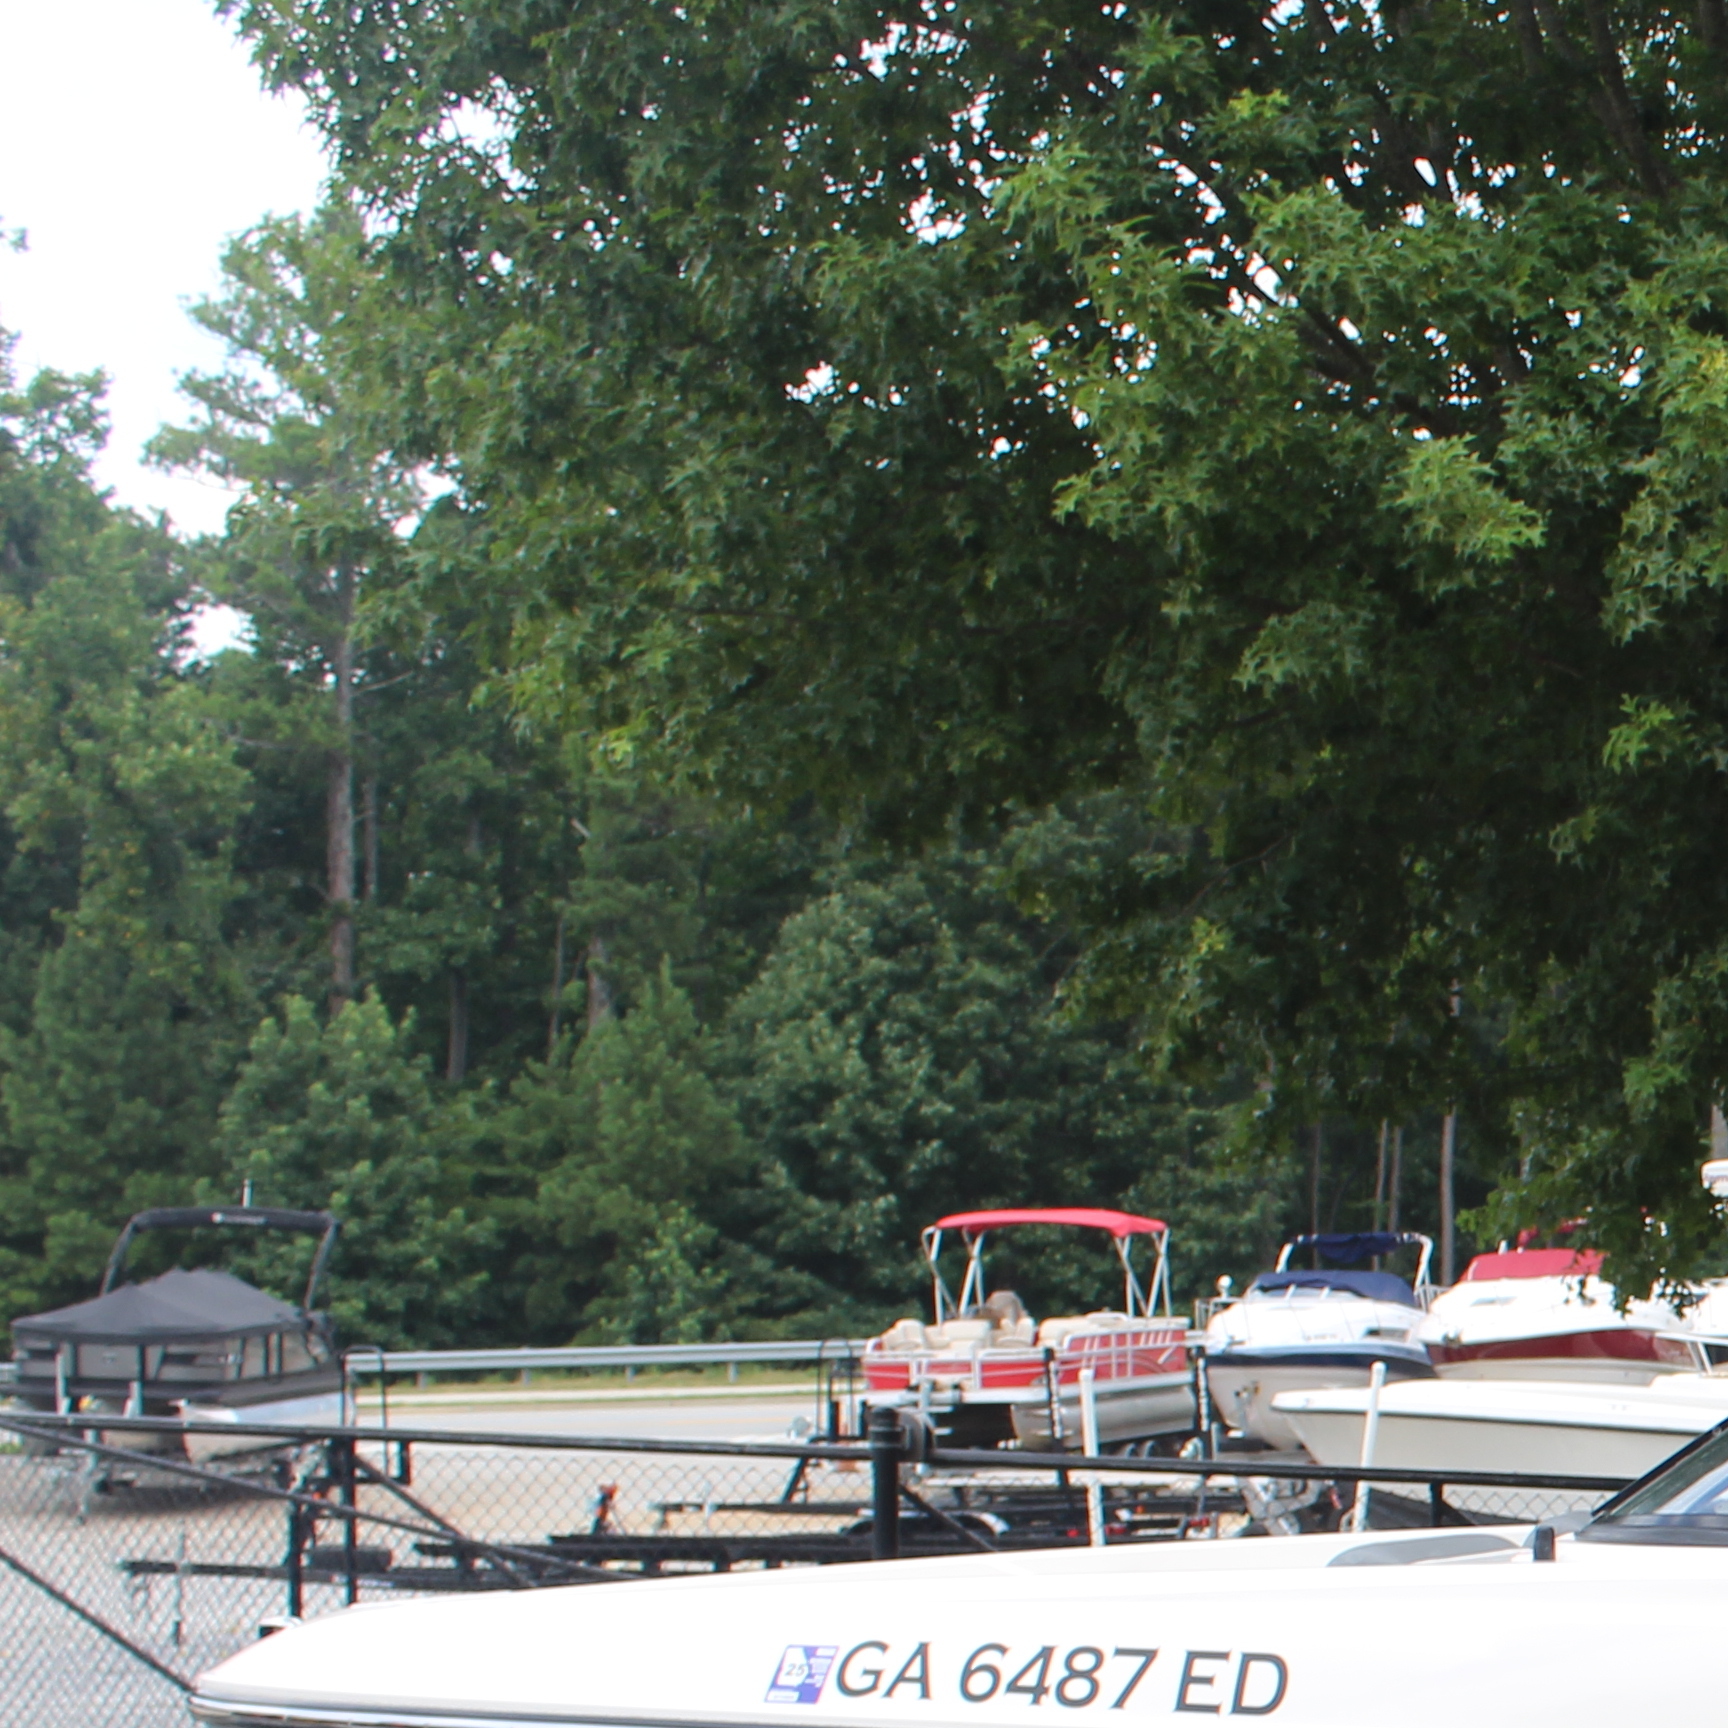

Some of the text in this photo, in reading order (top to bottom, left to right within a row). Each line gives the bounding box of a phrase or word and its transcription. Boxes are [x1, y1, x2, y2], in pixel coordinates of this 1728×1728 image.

[836, 1640, 1290, 1716] GA 6487 ED
